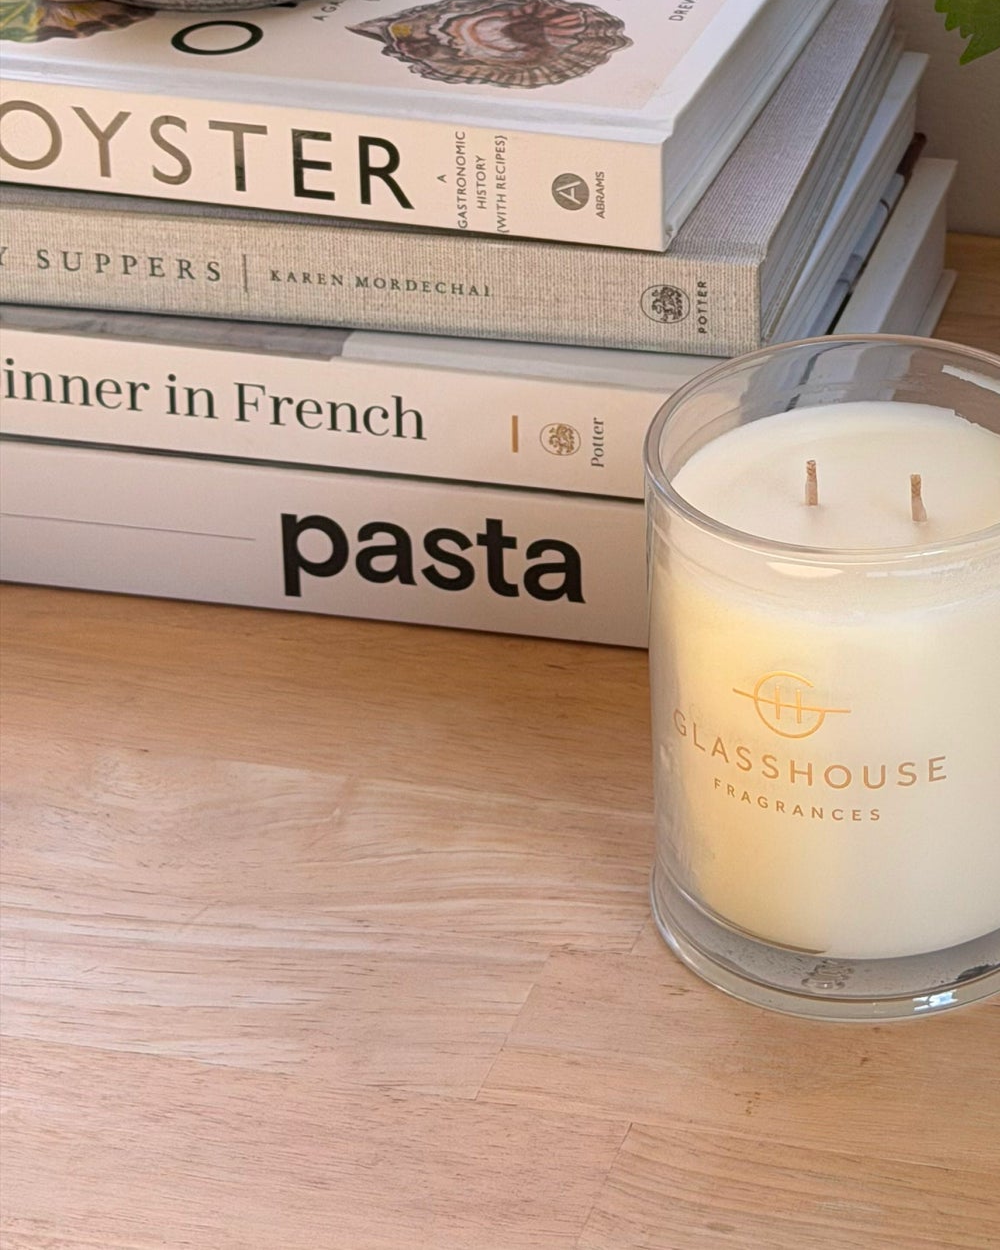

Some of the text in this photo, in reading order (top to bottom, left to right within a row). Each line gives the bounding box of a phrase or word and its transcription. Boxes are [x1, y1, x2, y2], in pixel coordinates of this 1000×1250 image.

[0, 100, 415, 210] OYSTER
[437, 174, 447, 183] A
[455, 131, 468, 230] GASTRONOMIC
[475, 155, 488, 210] HISTORY
[595, 171, 605, 219] ABRAMS
[37, 249, 493, 298] SUPPERS KAREN MORDECHAI
[697, 281, 708, 334] POTTER
[164, 373, 219, 420] in
[234, 382, 427, 441] French
[590, 417, 605, 468] Potter
[280, 513, 586, 604] pasta
[673, 708, 948, 790] GLASSHOUSE
[714, 777, 881, 822] FRAGRANCES
